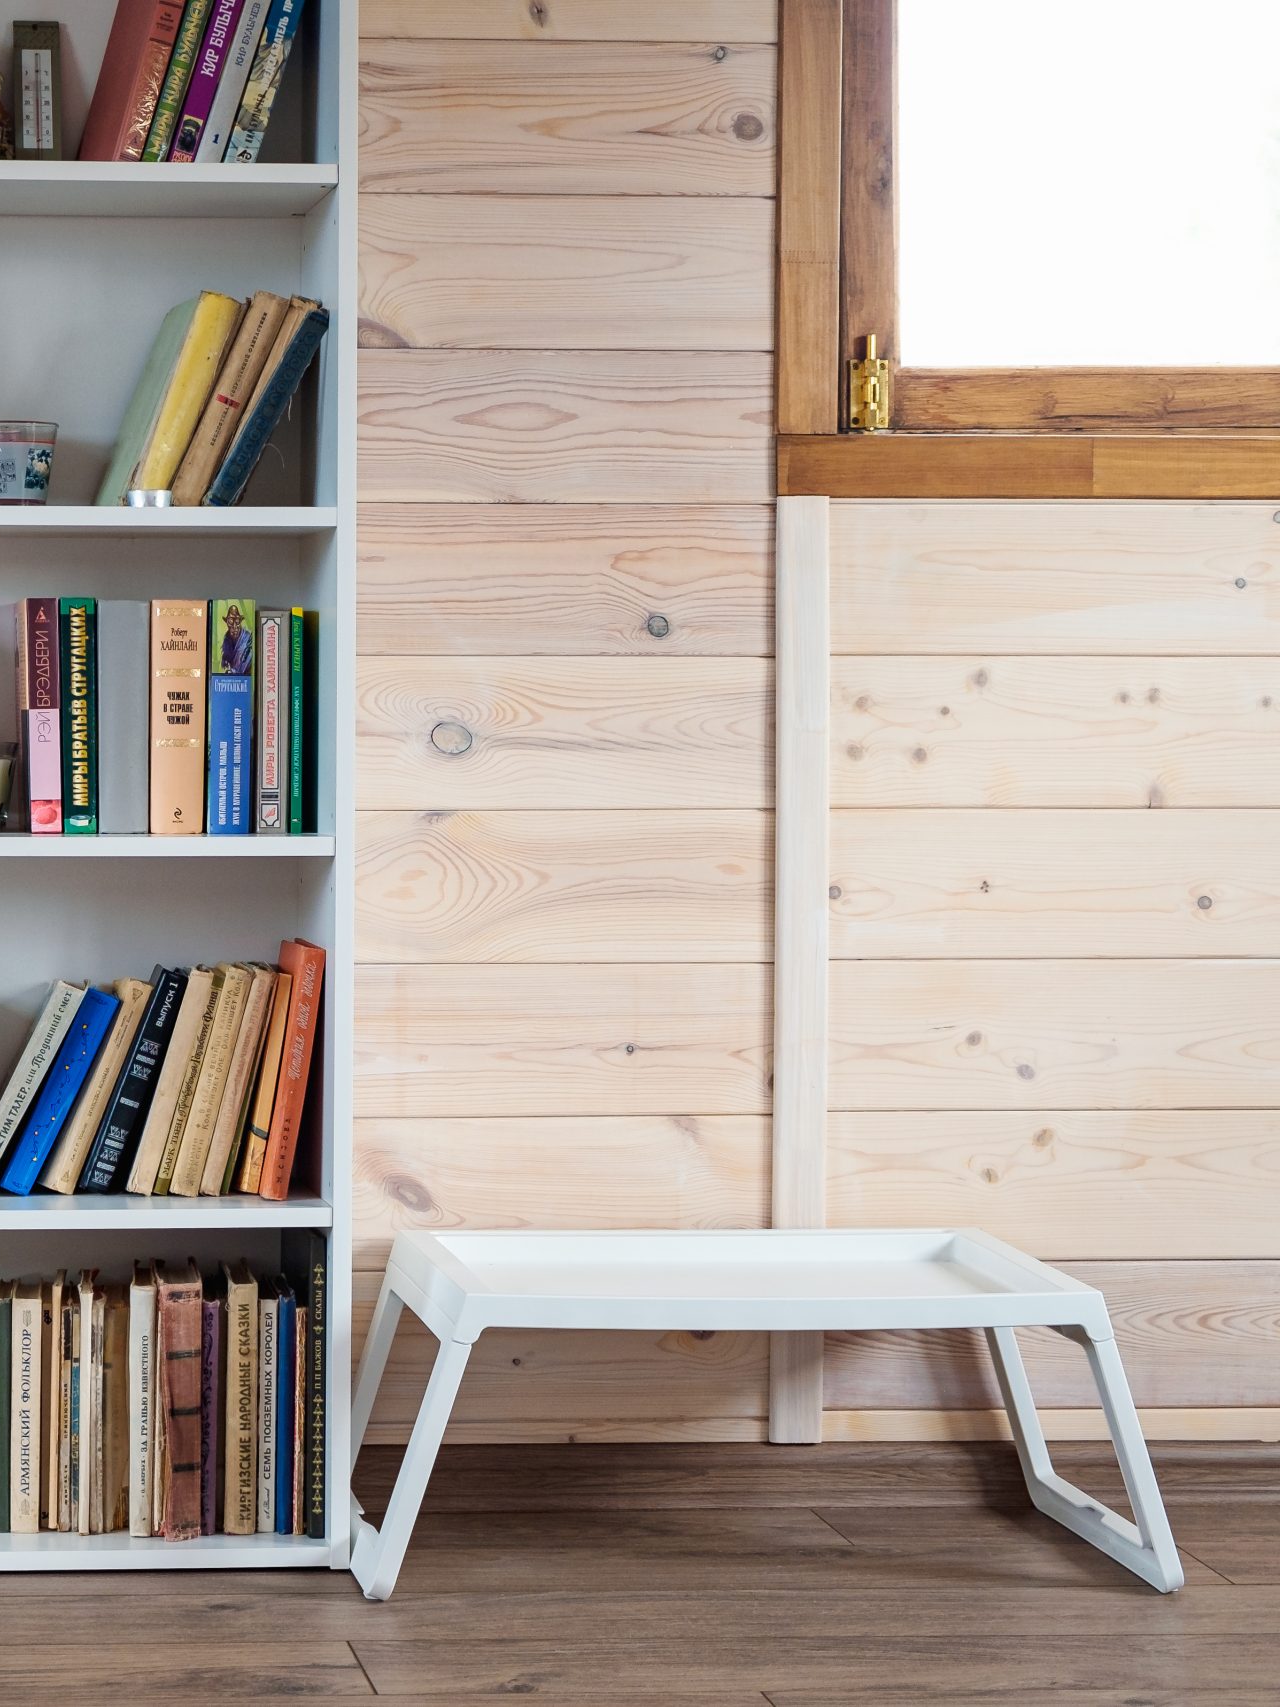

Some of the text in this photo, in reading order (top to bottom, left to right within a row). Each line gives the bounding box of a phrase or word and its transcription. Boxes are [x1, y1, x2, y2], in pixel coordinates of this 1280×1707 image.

[234, 1, 263, 67] КИР БУЛЫЧЕВ
[200, 48, 221, 77] КИР
[145, 66, 185, 155] МИРЫ КИРА
[160, 638, 198, 652] ХАЙНЛАЙН
[170, 627, 188, 638] Роберт
[35, 631, 51, 707] БРЭДБЕРИ
[69, 607, 90, 808] МИРЫ БРАТЬЕВ СТРУГАЦКИХ
[163, 703, 194, 713] В СТРАНЕ
[166, 691, 190, 701] ЧУЖАК
[266, 625, 276, 785] МИРЫ РОБЕРТА ХАЙНЛАЙНА
[35, 712, 52, 743] РЭЙ
[166, 713, 190, 725] ЧУЖОЙ
[300, 959, 317, 997] девочки
[57, 990, 74, 1013] смех
[294, 1001, 311, 1029] одной
[30, 1012, 63, 1069] Проданный
[287, 1032, 305, 1081] История
[25, 1068, 37, 1086] или
[162, 989, 219, 1177] МАРК ТВЕН Финна
[263, 1312, 273, 1365] КОРОЛЕЙ
[314, 1339, 322, 1371] БАЖОВ
[141, 1335, 149, 1392] ИЗВЕСТНОГО
[18, 1329, 32, 1496] АРМЯНСКИЙ ФОЛЬКЛОР
[238, 1302, 252, 1521] КИРГИЗСКИЕ НАРОДНЫЕ СКАЗКИ
[264, 1370, 273, 1443] ПОДЗЕМНЫХ
[141, 1440, 148, 1452] ЗА
[263, 1447, 271, 1480] СЕМЬ
